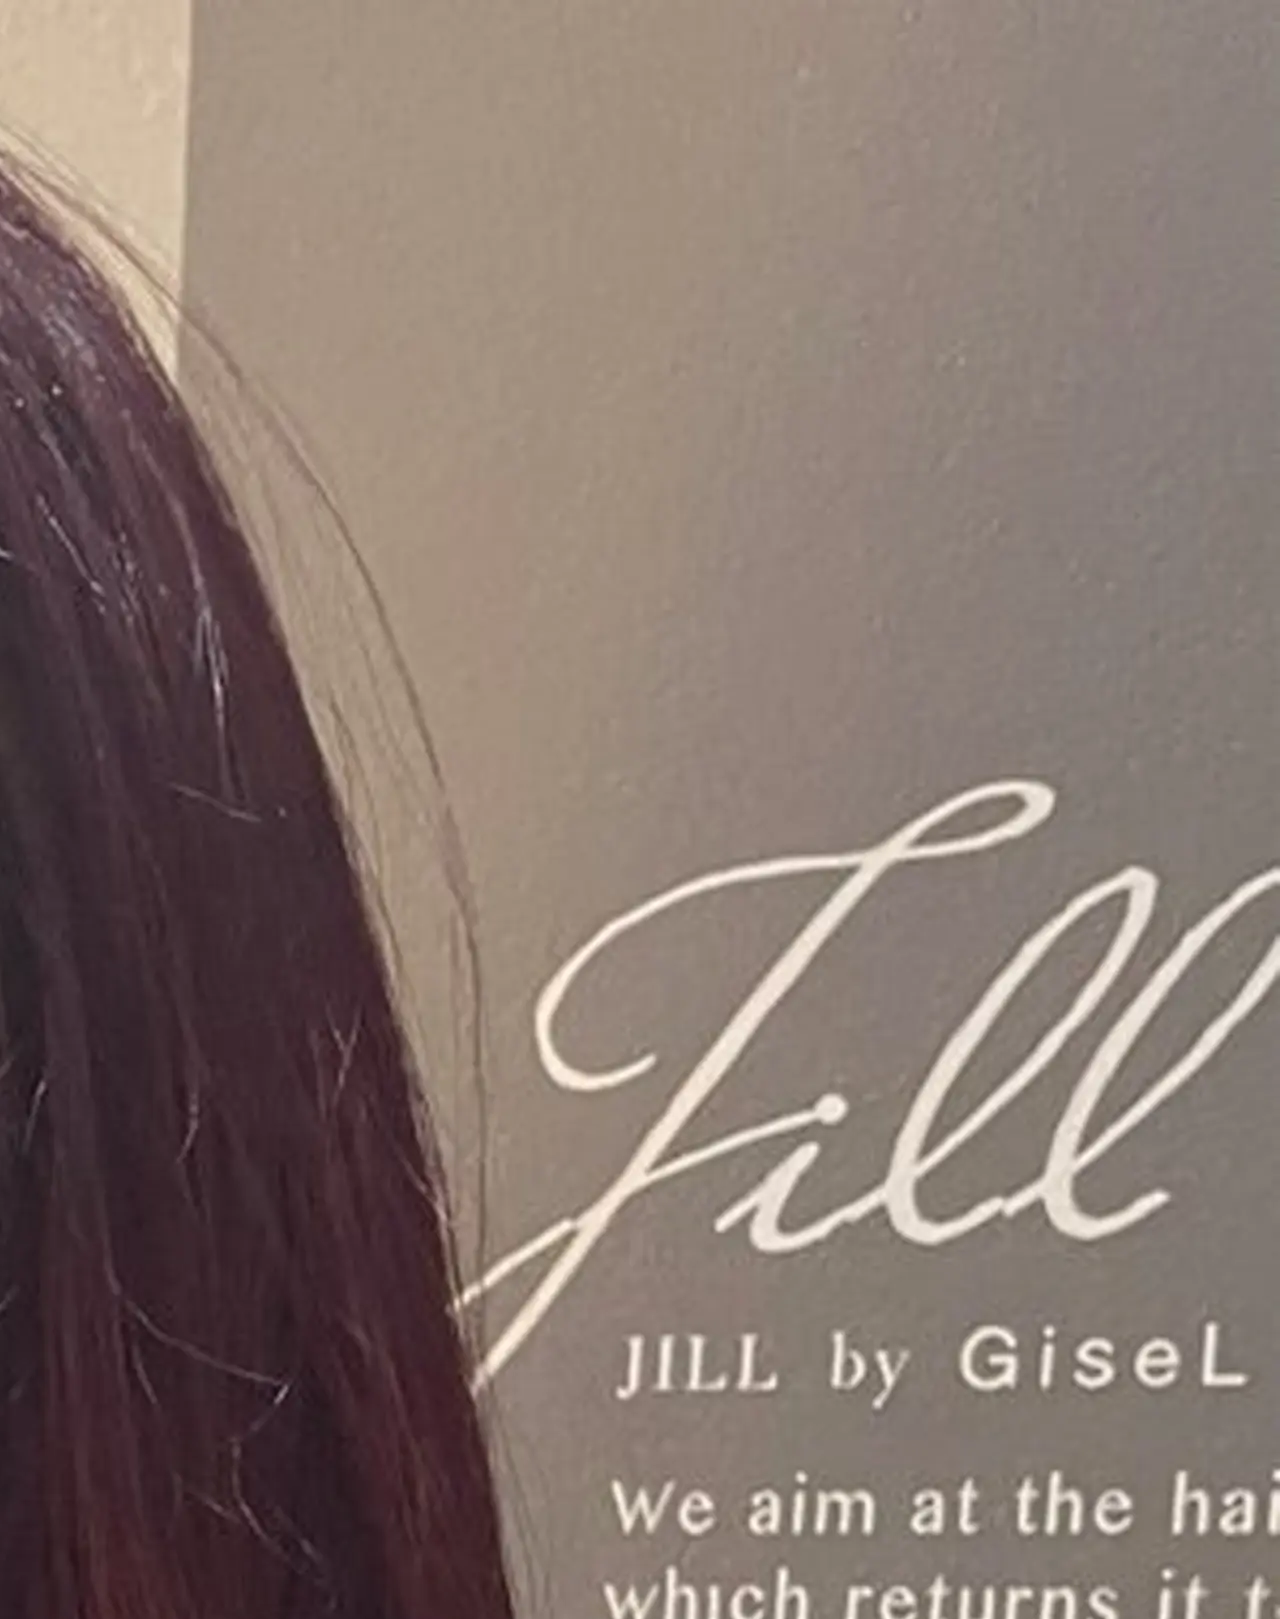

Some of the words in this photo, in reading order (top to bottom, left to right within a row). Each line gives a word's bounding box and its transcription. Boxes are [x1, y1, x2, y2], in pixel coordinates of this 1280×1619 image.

[615, 1333, 778, 1400] JILL
[830, 1330, 909, 1409] by
[959, 1321, 1248, 1391] GiseL
[610, 1479, 716, 1535] We
[747, 1471, 876, 1535] aim
[909, 1478, 979, 1536] at
[1016, 1470, 1133, 1536] the
